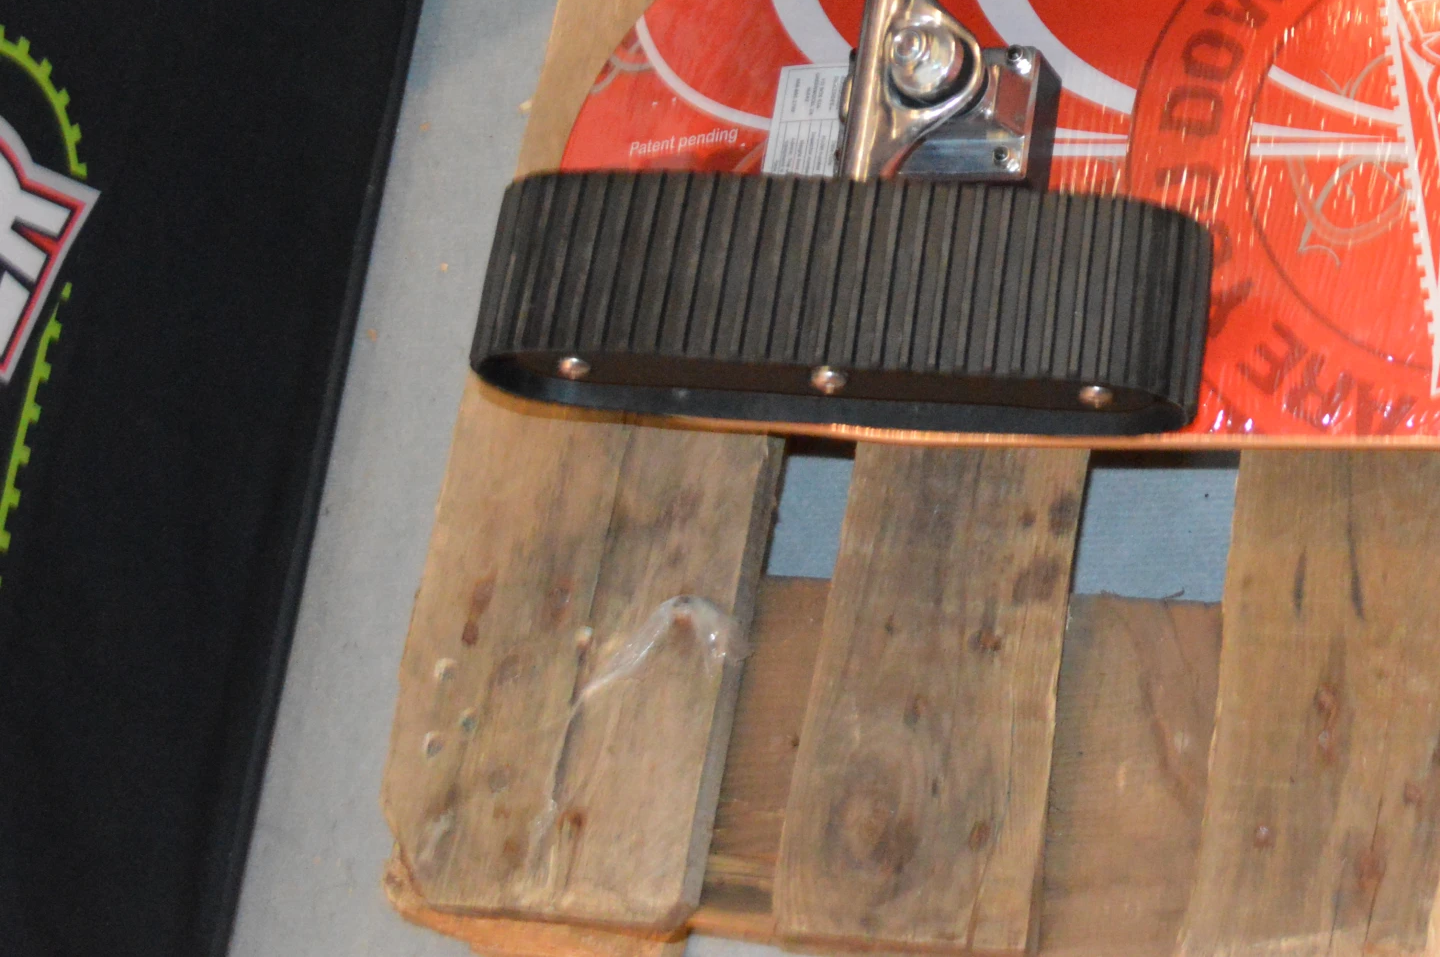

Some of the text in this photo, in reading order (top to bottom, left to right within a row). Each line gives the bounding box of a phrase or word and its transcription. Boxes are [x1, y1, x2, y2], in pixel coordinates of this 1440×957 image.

[628, 127, 739, 157] Patent pending
[1236, 320, 1419, 436] ARE
